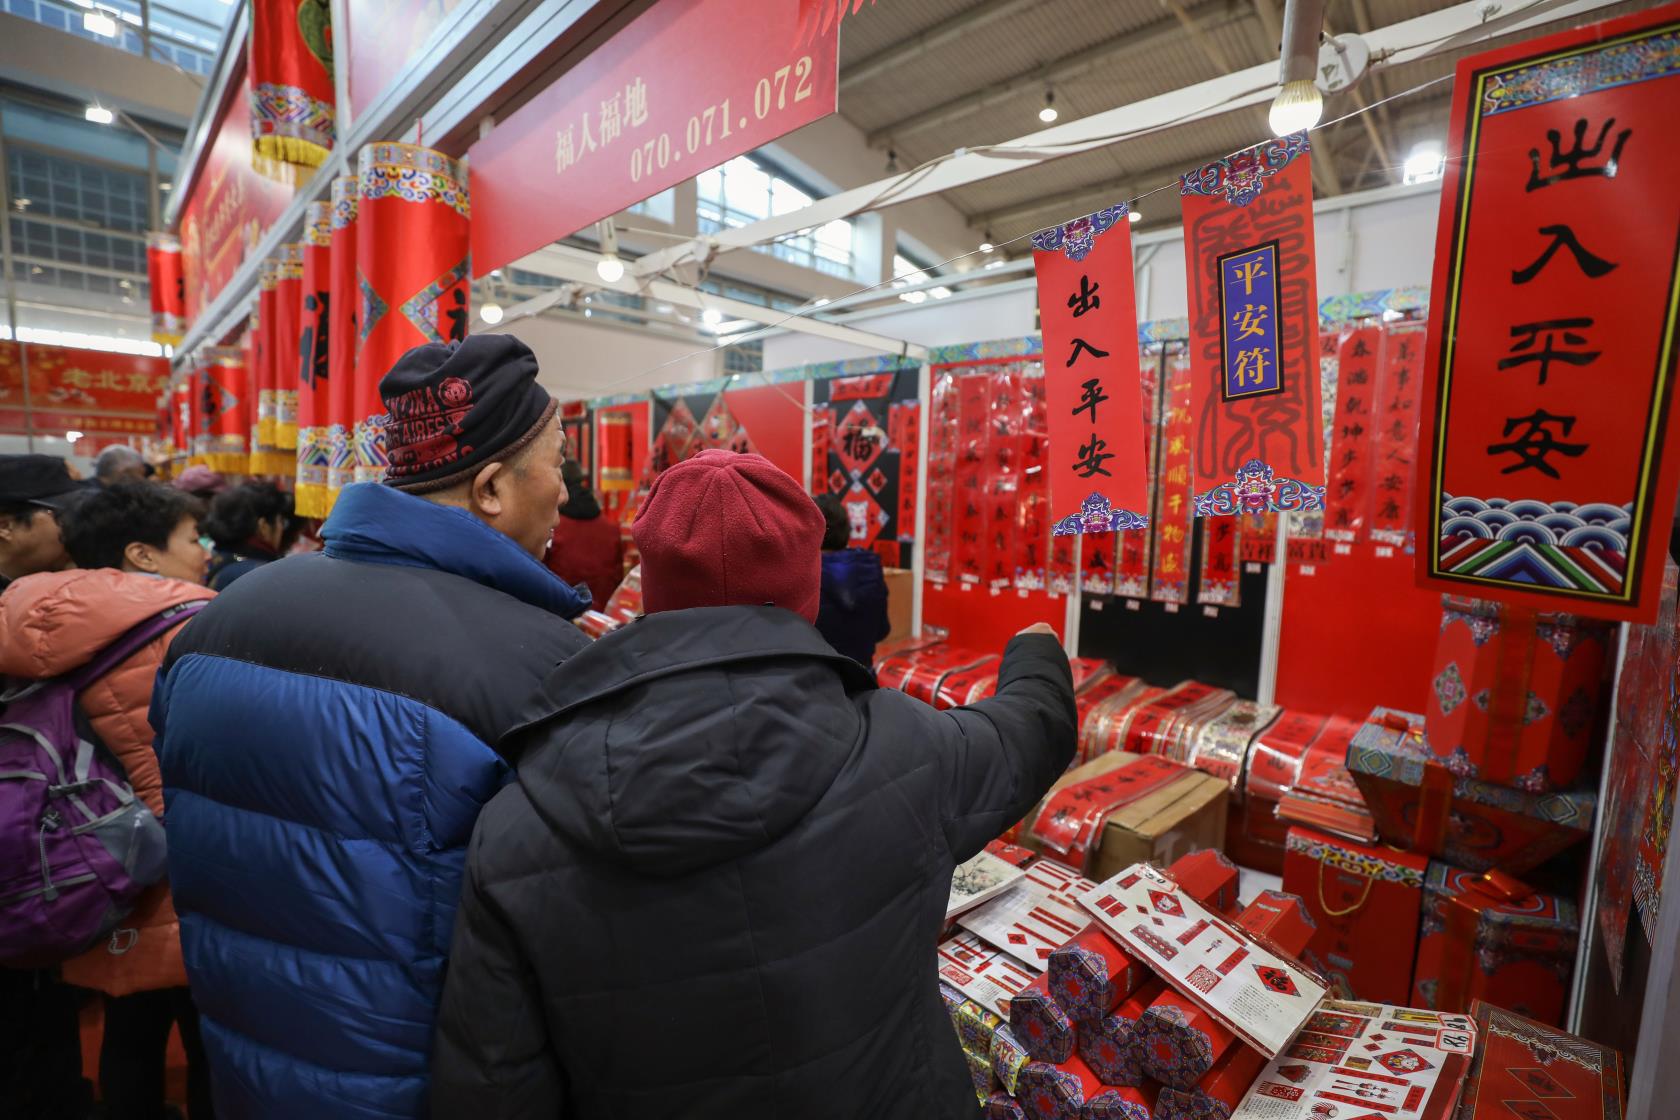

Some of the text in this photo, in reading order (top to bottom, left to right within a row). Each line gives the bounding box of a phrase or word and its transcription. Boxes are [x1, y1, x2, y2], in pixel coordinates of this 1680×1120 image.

[556, 77, 648, 175] 福人福地
[1229, 256, 1270, 386] 平安符
[1487, 118, 1632, 479] 出入平安
[1066, 275, 1115, 478] 出入平安
[1264, 970, 1289, 991] 福
